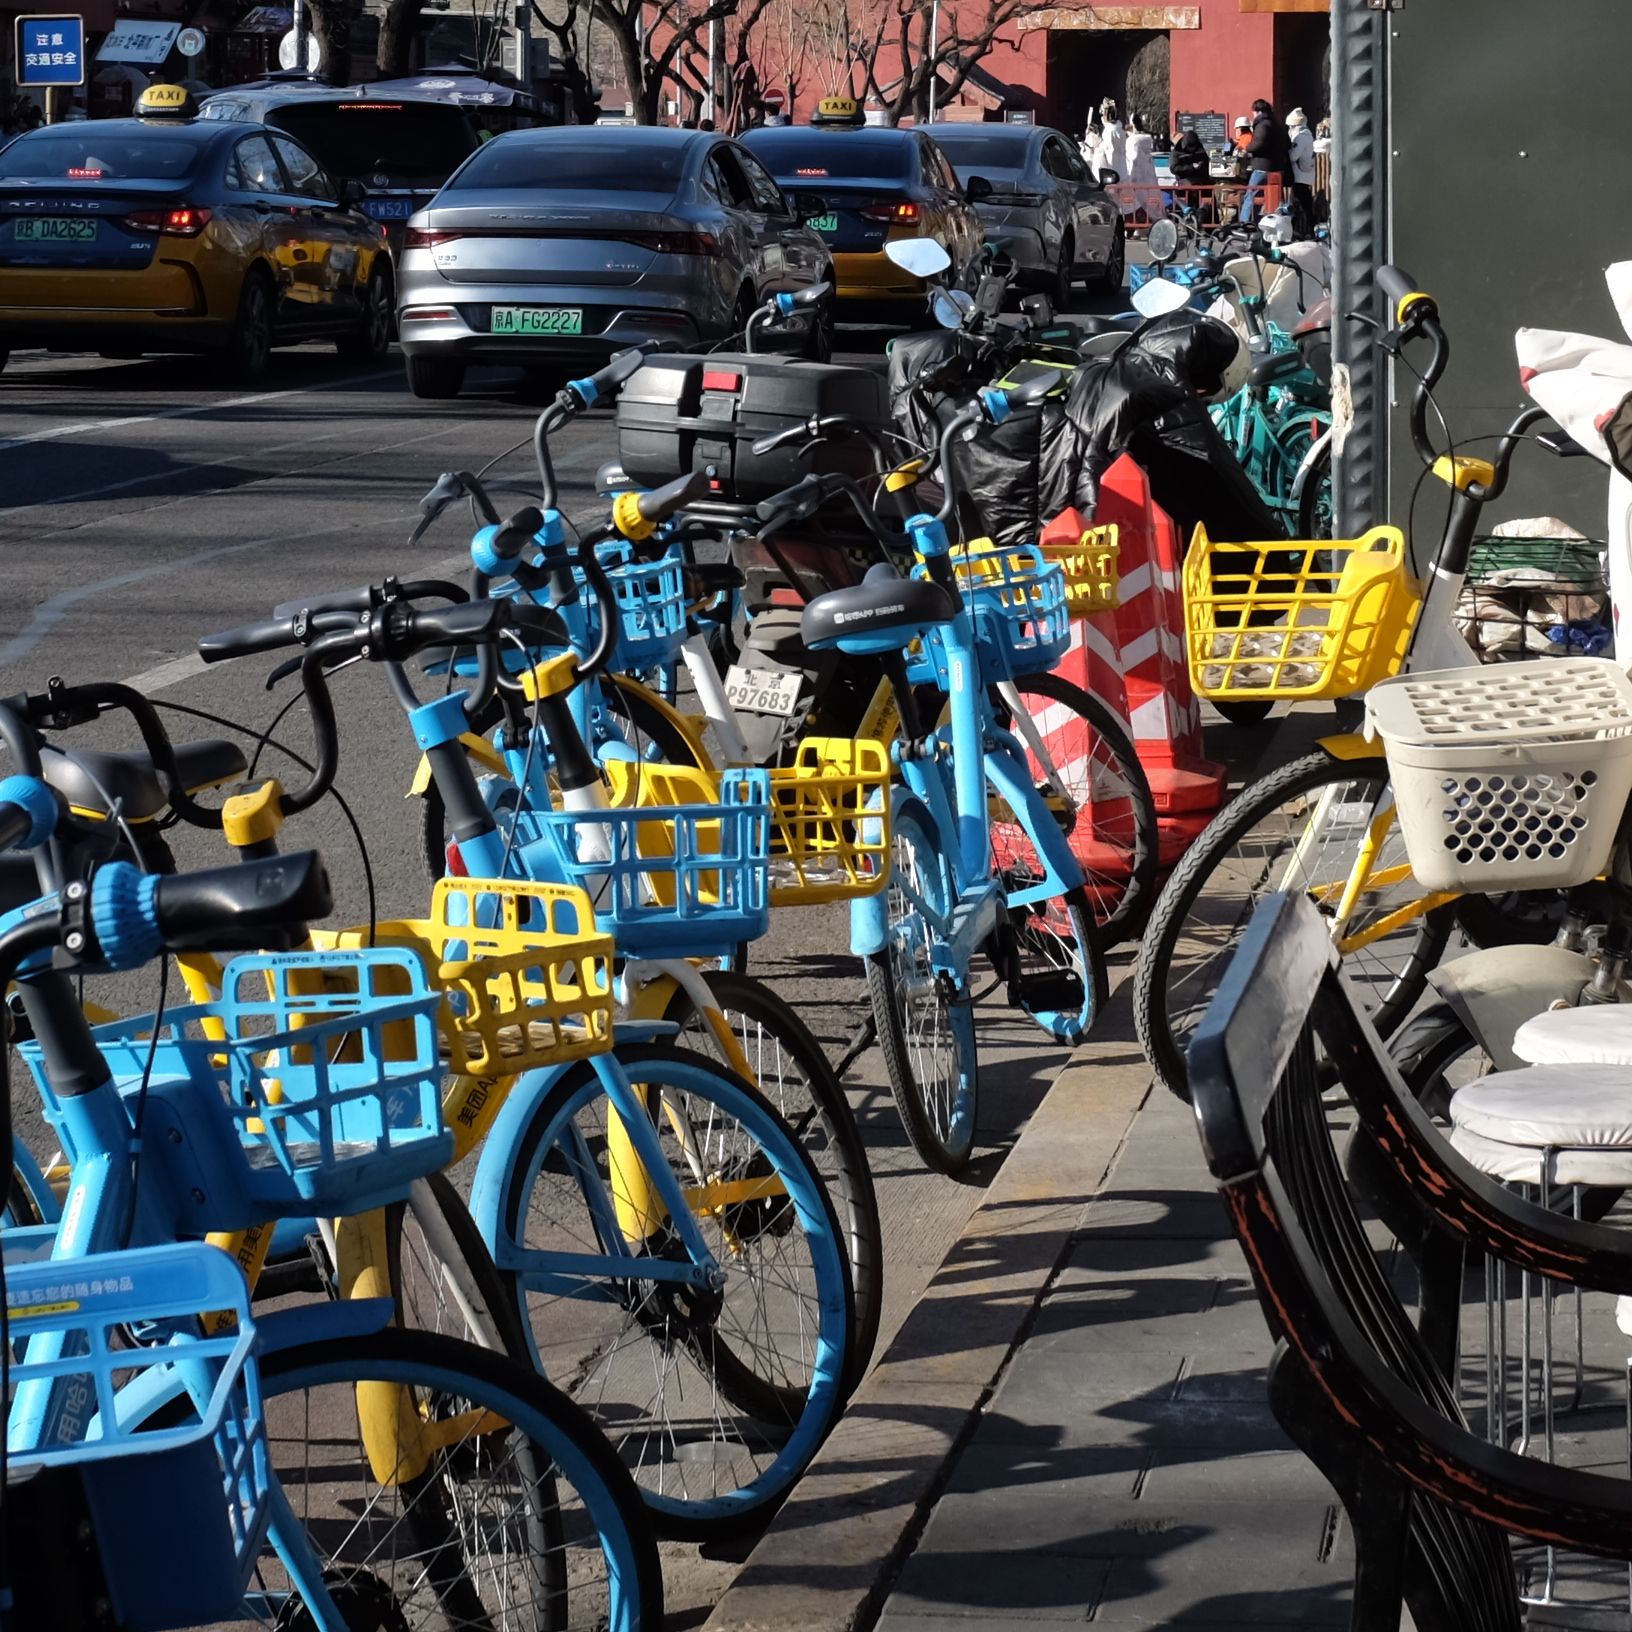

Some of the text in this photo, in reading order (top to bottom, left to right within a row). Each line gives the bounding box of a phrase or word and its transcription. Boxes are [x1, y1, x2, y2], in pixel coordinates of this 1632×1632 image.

[36, 32, 64, 46] 注意
[25, 51, 77, 66] 交通安全
[148, 90, 181, 101] TAXI
[824, 101, 852, 111] TAXI
[728, 685, 792, 711] P97683
[236, 1223, 266, 1274] 用美
